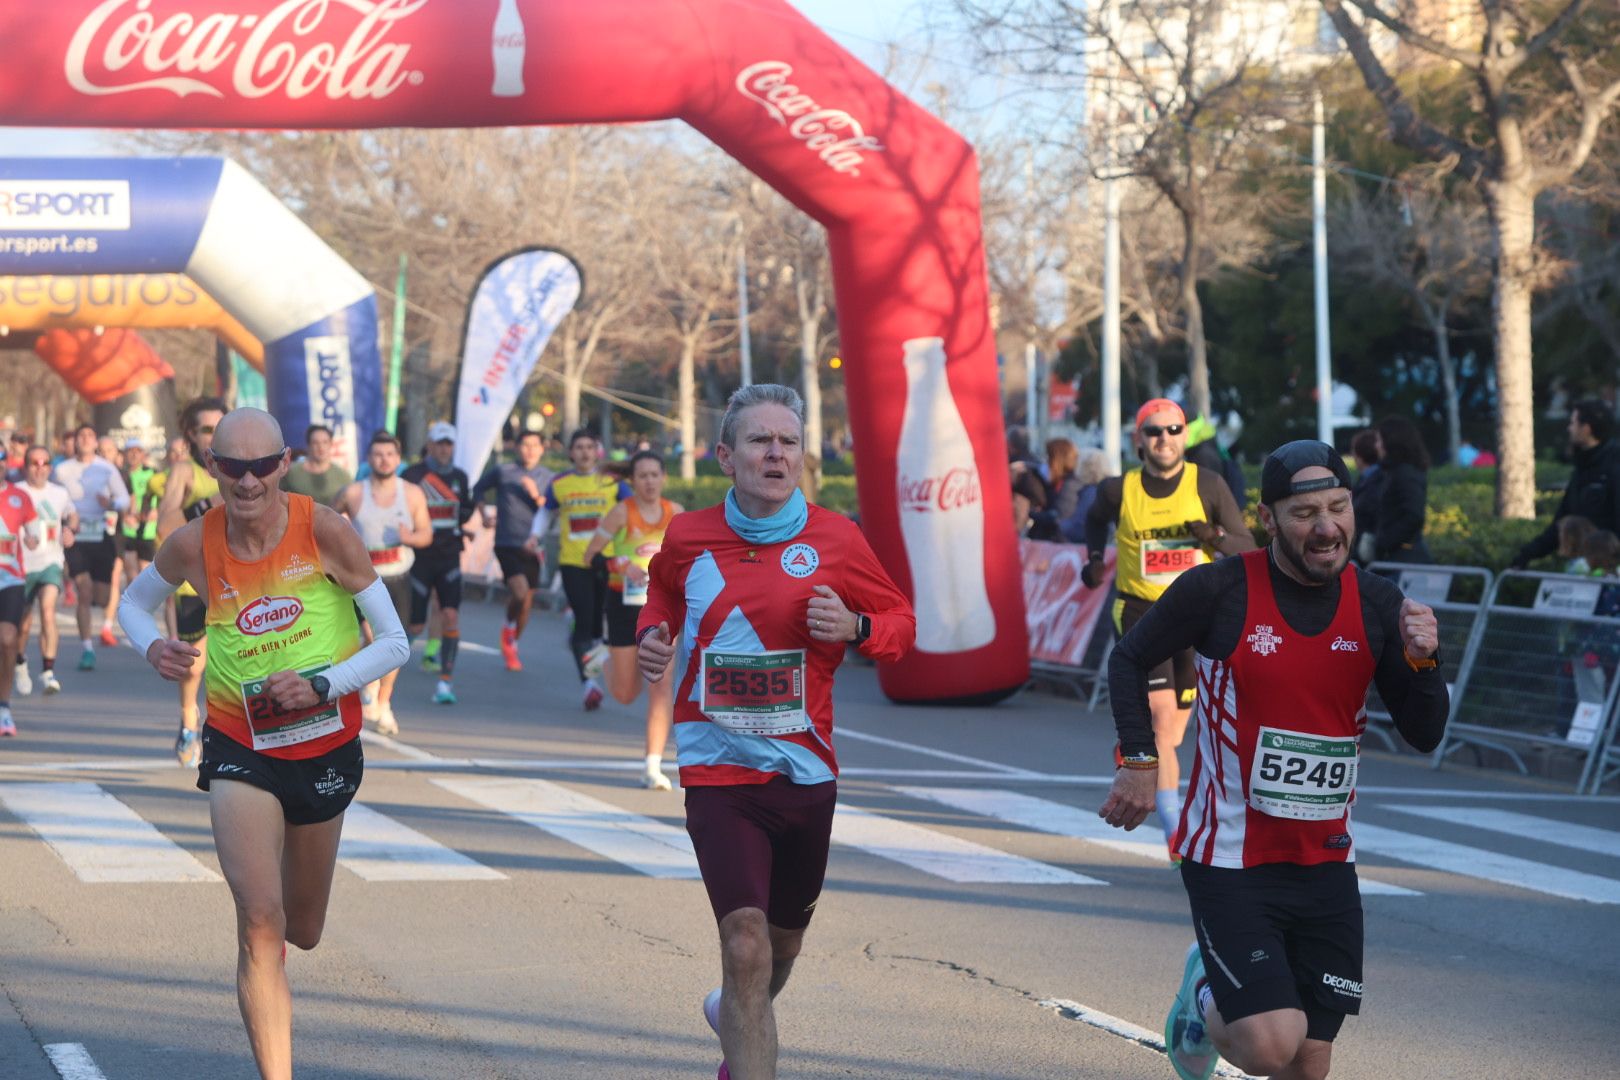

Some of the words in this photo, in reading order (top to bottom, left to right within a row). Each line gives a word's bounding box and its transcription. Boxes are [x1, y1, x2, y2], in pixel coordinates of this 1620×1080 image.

[735, 60, 886, 175] Coca-Cola
[1146, 551, 1193, 567] 2495
[244, 604, 299, 630] Serrano
[237, 647, 260, 659] COME
[261, 640, 281, 653] BIEN
[282, 638, 288, 648] Y
[289, 627, 313, 645] CORRE
[709, 670, 789, 697] 2535
[1260, 752, 1347, 789] 5249
